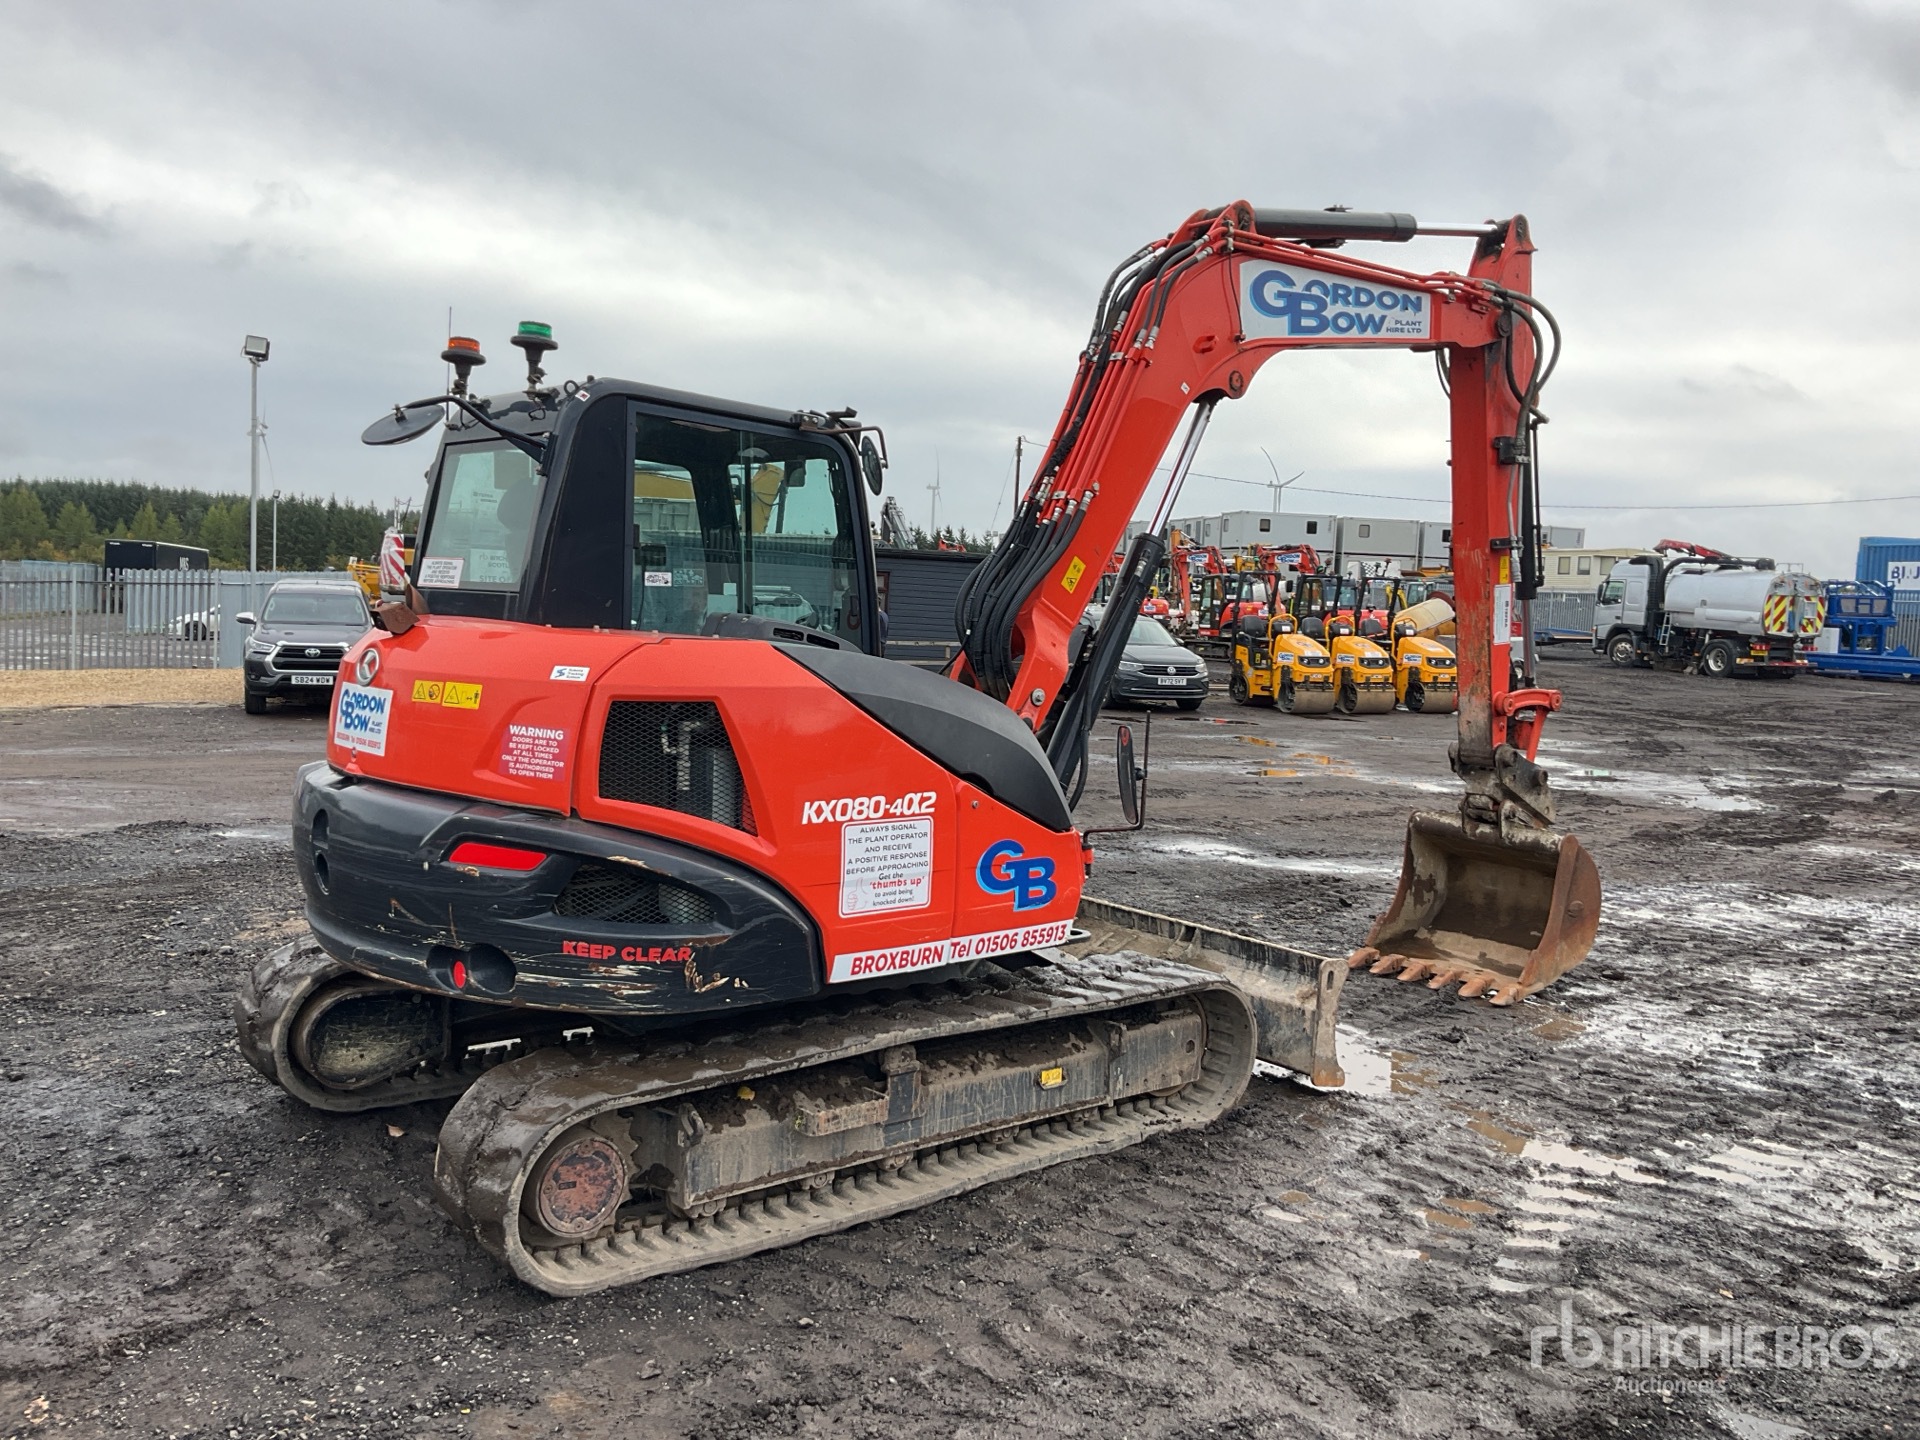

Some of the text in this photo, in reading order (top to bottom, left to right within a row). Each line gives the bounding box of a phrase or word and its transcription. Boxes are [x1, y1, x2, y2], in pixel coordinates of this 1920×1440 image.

[1250, 270, 1422, 318] GORDON
[1278, 290, 1387, 335] BOW
[1394, 319, 1422, 327] PLANT
[1386, 326, 1422, 334] HIRE LTD
[340, 688, 386, 717] GORDON
[344, 700, 371, 733] BOW
[509, 724, 564, 740] WARNING
[512, 736, 533, 744] DOORS
[534, 738, 547, 746] ARE
[517, 743, 533, 751] KEPT
[533, 745, 559, 754] LOCKED
[534, 751, 553, 760] TIMES
[515, 762, 555, 773] AUTHORISED
[530, 758, 565, 768] OPERATOR
[517, 769, 535, 777] OPEN
[535, 771, 553, 780] THEM
[859, 823, 918, 834] ALWAYS SIGNAL
[864, 835, 889, 844] PLANT
[890, 831, 929, 841] OPERATOR
[864, 842, 913, 853] AND RECEIVE
[854, 854, 889, 864] POSITIVE
[889, 850, 928, 861] RESPONSE
[845, 860, 929, 875] BEFORE APPROACHING
[878, 871, 904, 881] Get the
[976, 838, 1057, 913] GB
[882, 888, 897, 897] avoid
[898, 888, 914, 898] being
[872, 897, 897, 907] knocked
[562, 940, 692, 962] KEEP CLEAR
[850, 923, 1067, 976] BROXBURN Tel 01506 855913
